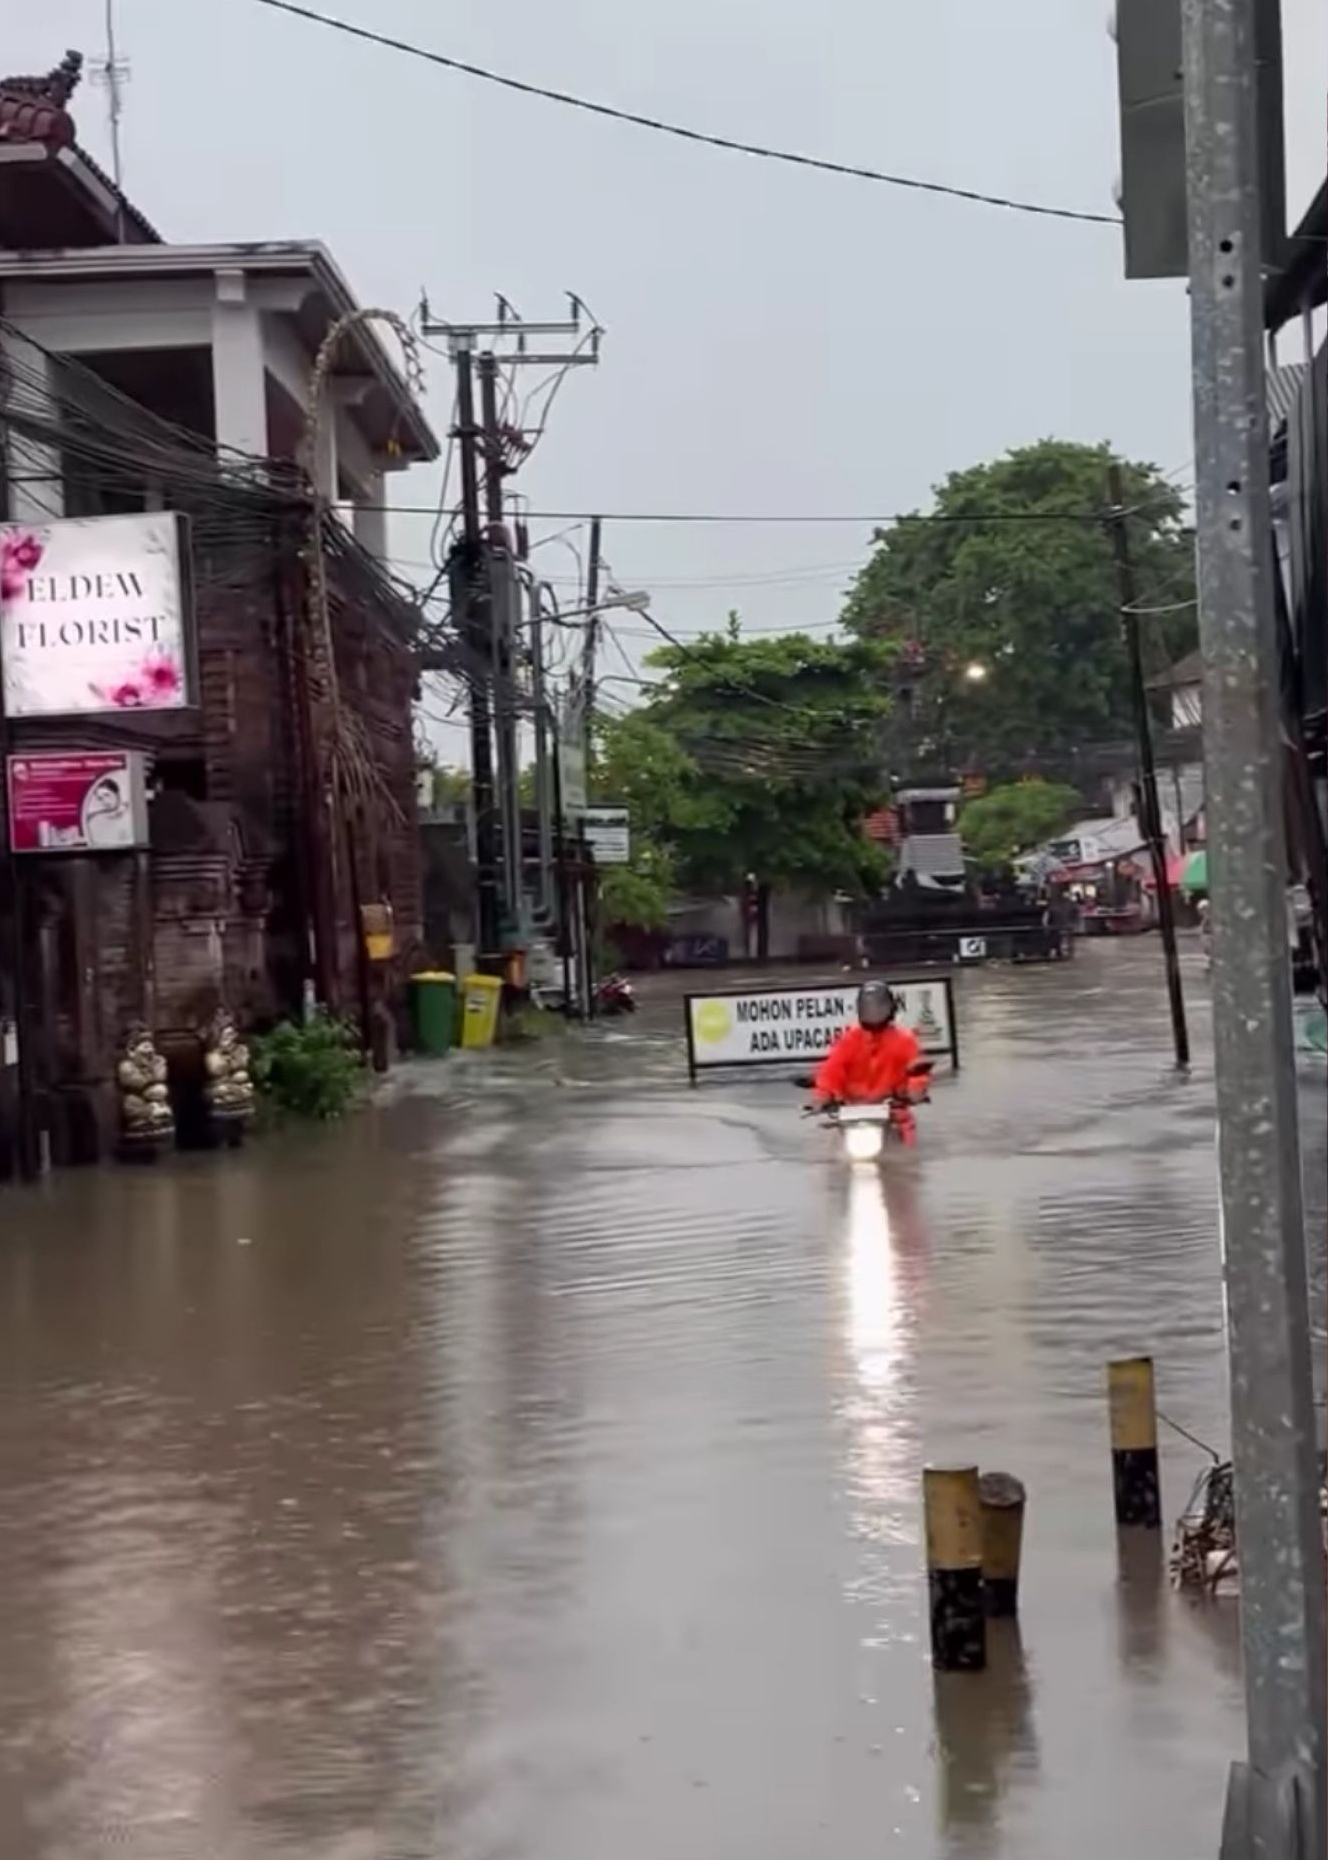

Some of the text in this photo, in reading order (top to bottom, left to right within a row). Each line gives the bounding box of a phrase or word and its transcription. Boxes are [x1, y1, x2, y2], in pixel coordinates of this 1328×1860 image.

[28, 572, 143, 602] ELDEW
[18, 615, 166, 649] FLORIST
[737, 1000, 792, 1022] MOHON
[796, 997, 844, 1019] PELAN
[750, 1030, 780, 1052] ADA
